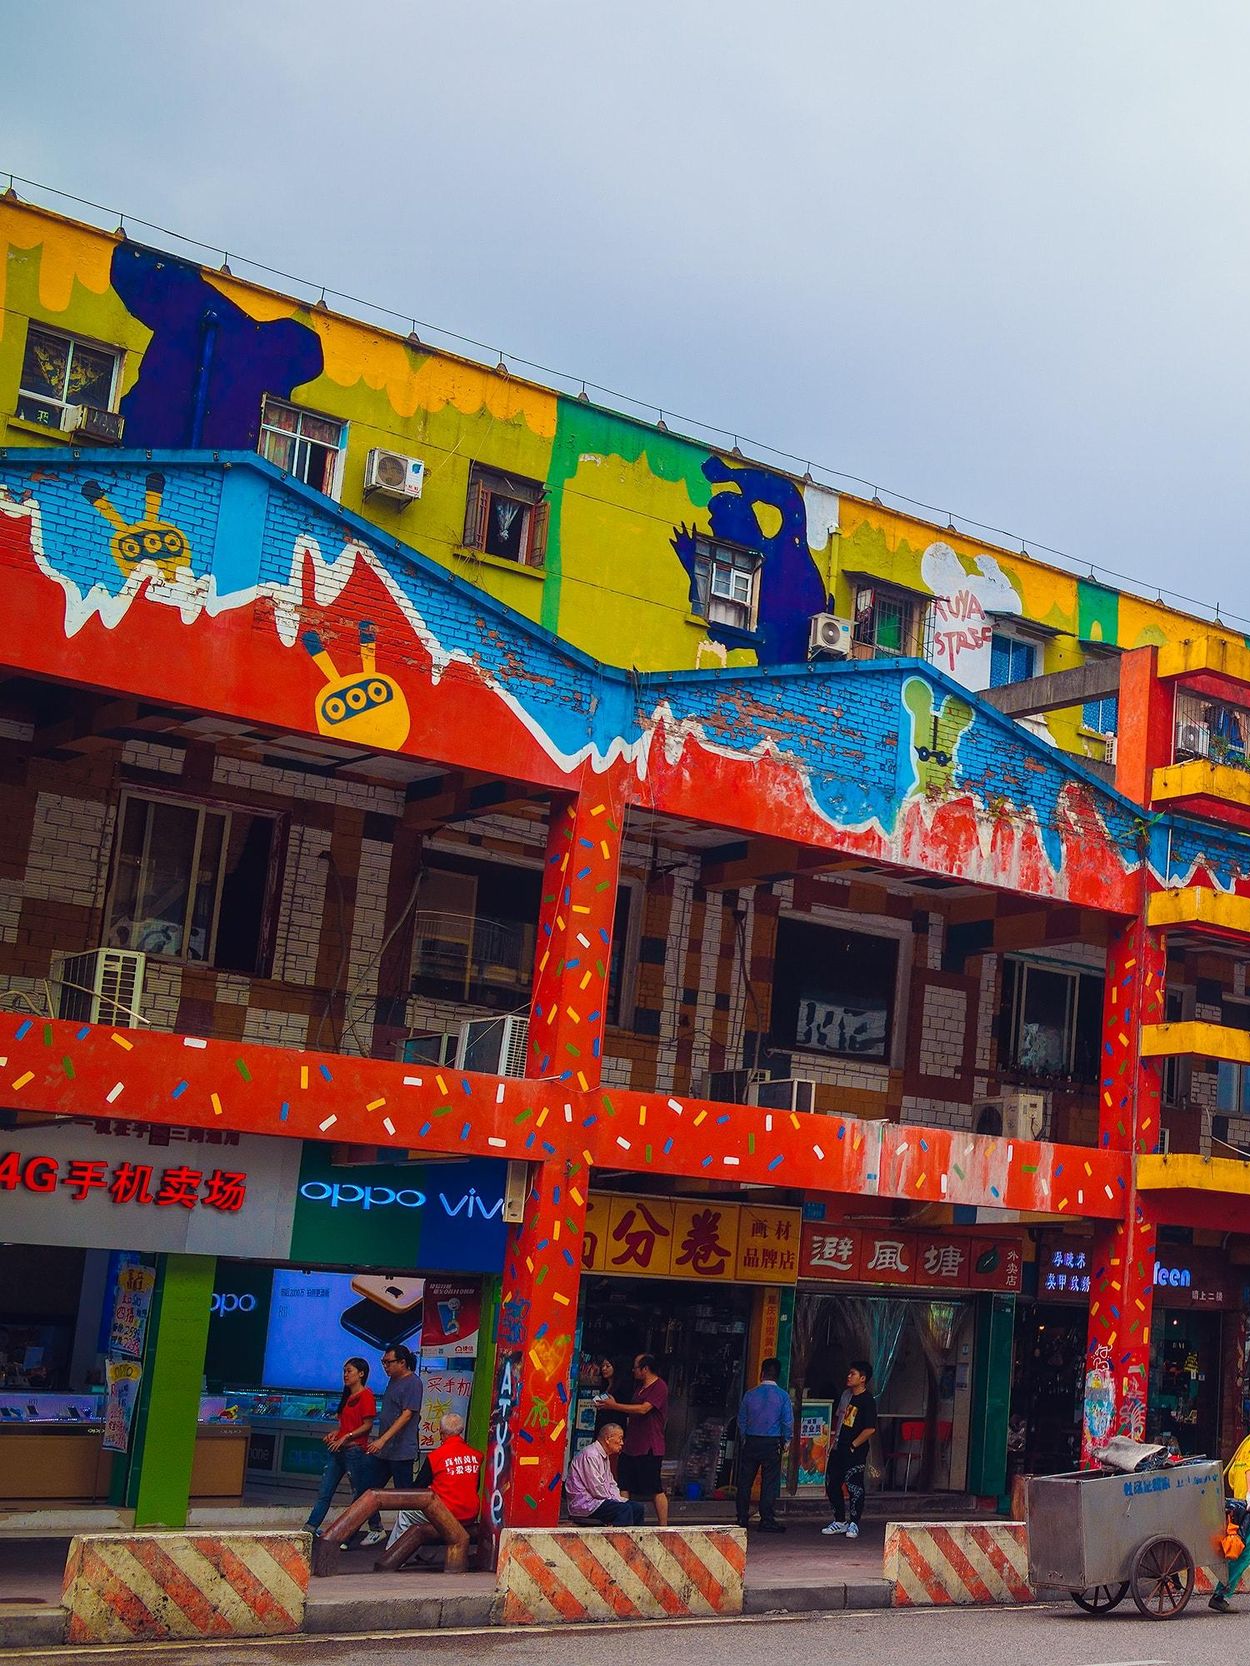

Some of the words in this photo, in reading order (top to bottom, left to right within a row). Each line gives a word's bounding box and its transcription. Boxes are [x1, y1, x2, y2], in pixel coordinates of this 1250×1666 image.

[0, 1151, 247, 1211] 4G手机卖场
[439, 1187, 505, 1219] viv
[743, 1248, 795, 1270] 品牌店
[1005, 1249, 1019, 1287] 外卖店
[427, 1376, 472, 1397] 买手机
